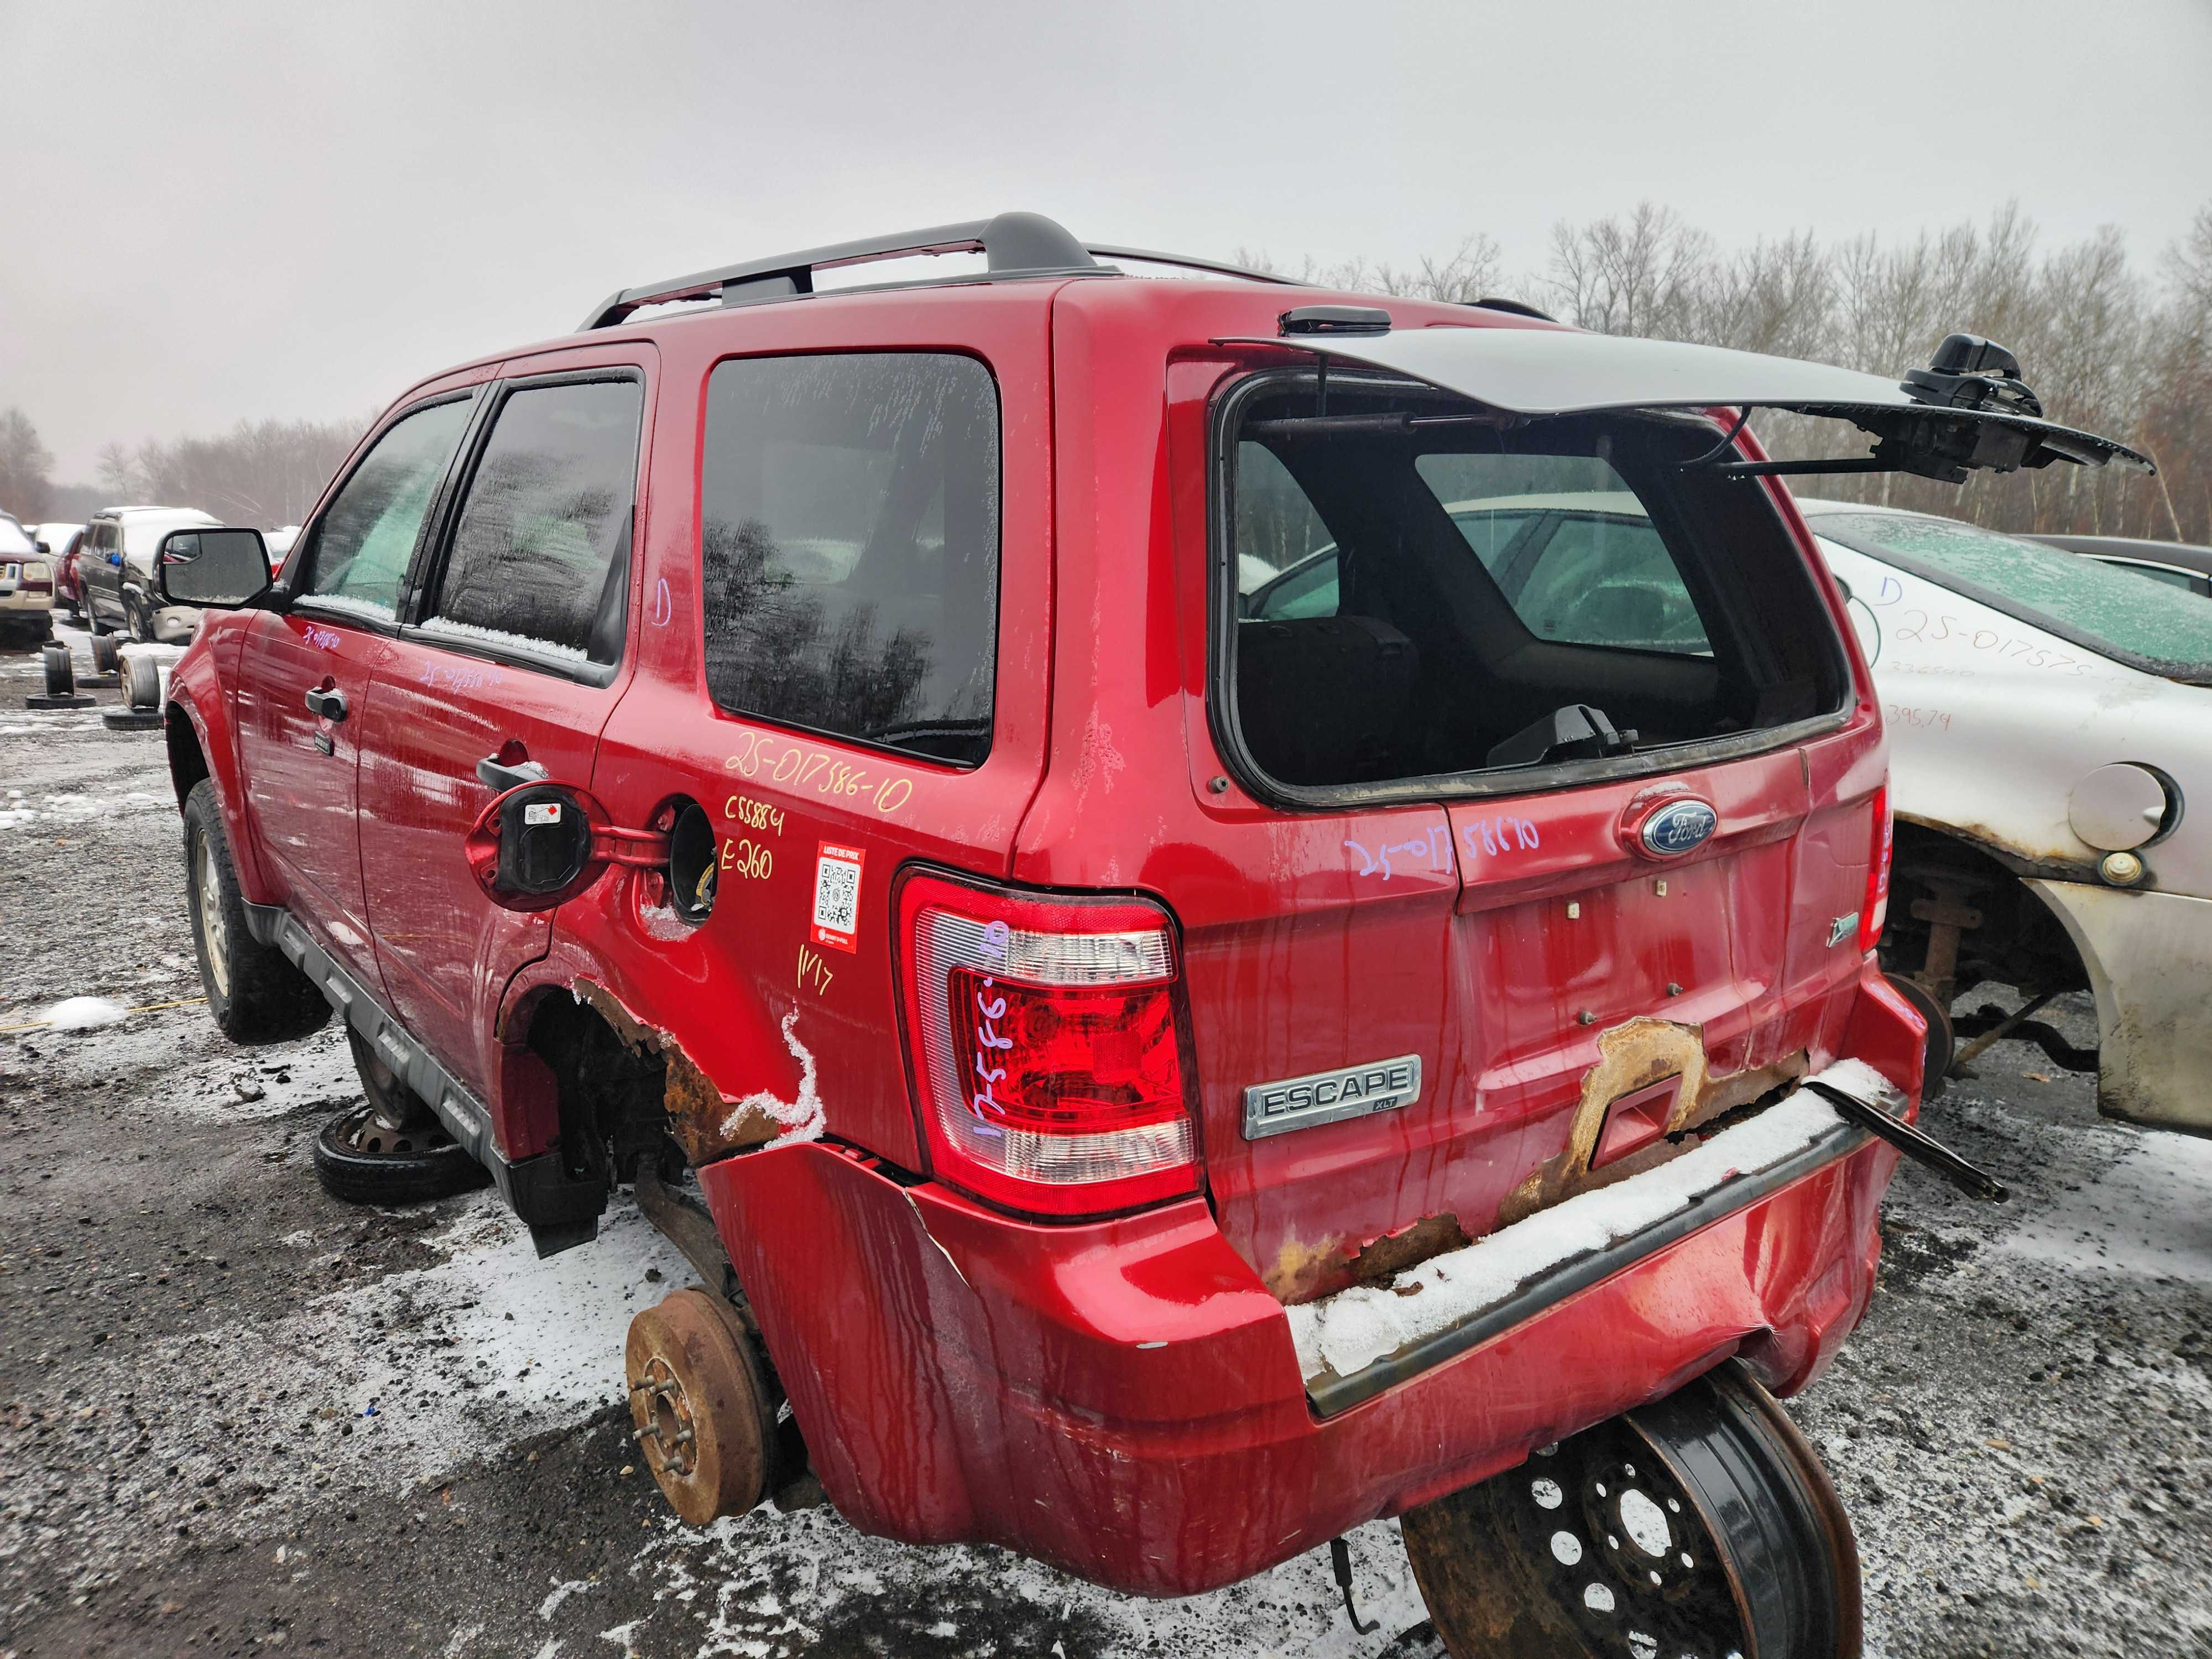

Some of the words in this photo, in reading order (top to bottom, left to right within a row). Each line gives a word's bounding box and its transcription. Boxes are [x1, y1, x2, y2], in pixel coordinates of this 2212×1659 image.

[725, 732, 912, 812] 25-017586-10
[725, 795, 785, 837] C55884
[1668, 811, 1706, 844] Ford
[823, 846, 838, 857] LISTE
[838, 848, 846, 858] DE
[846, 850, 859, 860] PRIX
[1263, 1066, 1408, 1117] ESCAPE
[1375, 1098, 1396, 1110] XLT
